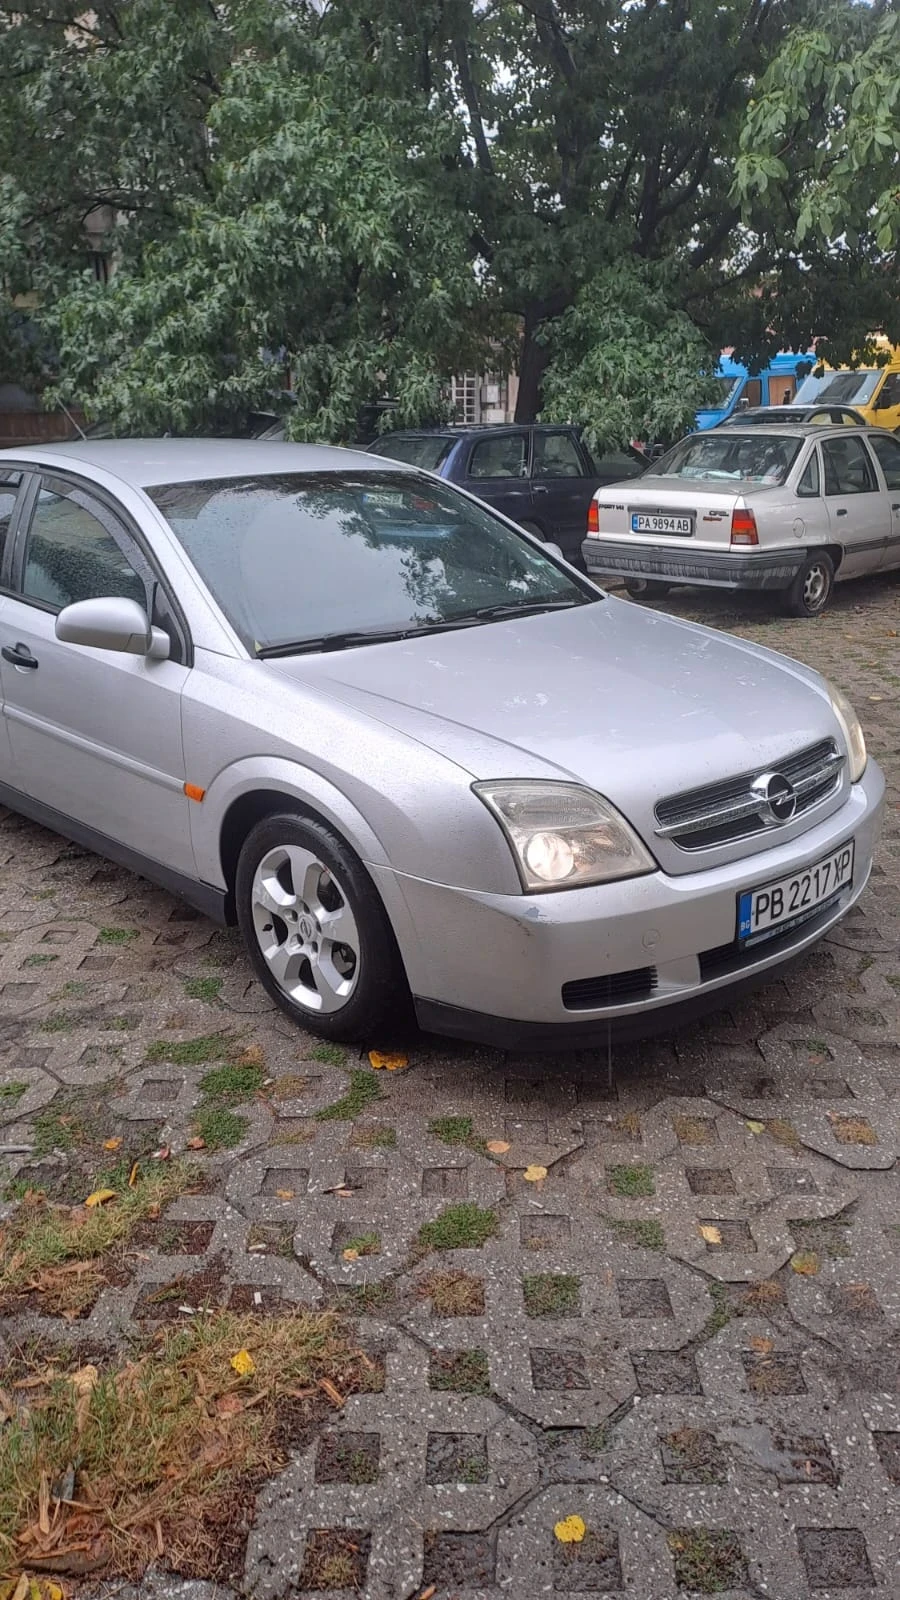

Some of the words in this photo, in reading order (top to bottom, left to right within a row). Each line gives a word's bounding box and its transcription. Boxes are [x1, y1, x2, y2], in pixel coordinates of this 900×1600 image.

[638, 516, 651, 529] PA
[653, 517, 675, 531] 9894
[677, 518, 689, 532] AB
[755, 887, 784, 926] PB
[789, 862, 832, 913] 2217
[833, 849, 851, 887] XP
